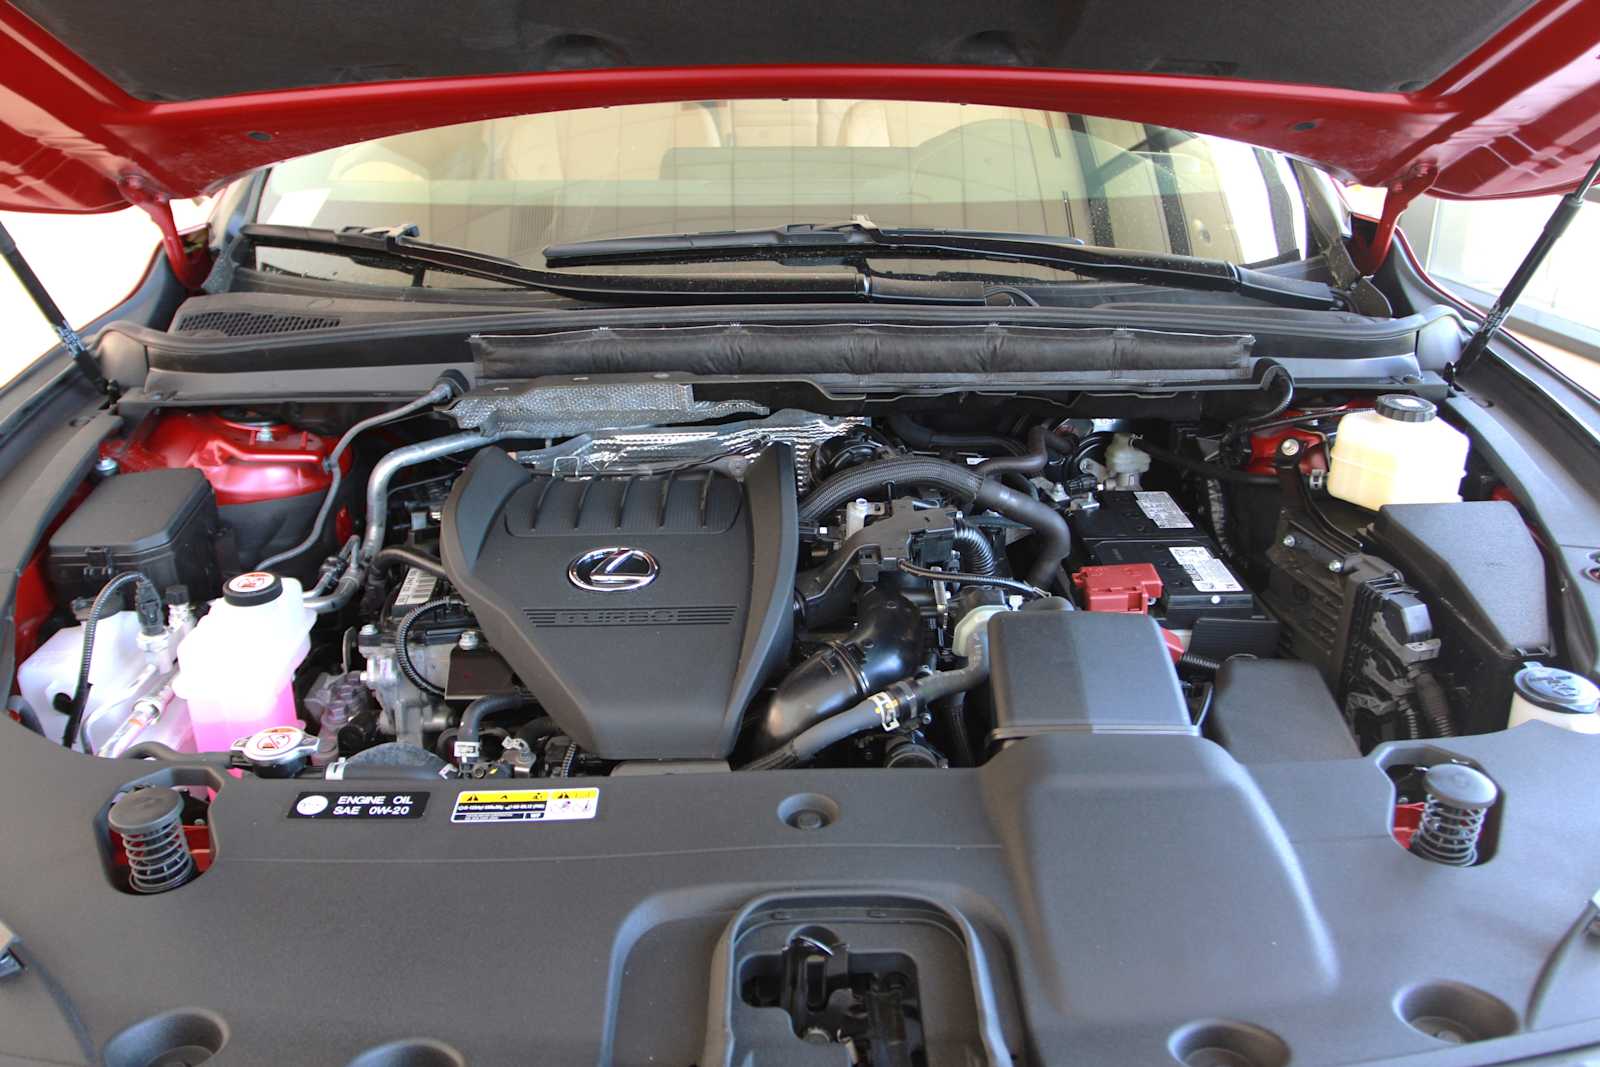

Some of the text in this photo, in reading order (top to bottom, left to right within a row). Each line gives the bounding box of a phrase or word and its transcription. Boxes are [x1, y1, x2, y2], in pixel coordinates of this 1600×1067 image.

[558, 610, 679, 625] TURBO
[337, 795, 414, 805] ENGINE OIL
[332, 806, 410, 815] SAE 0W-20
